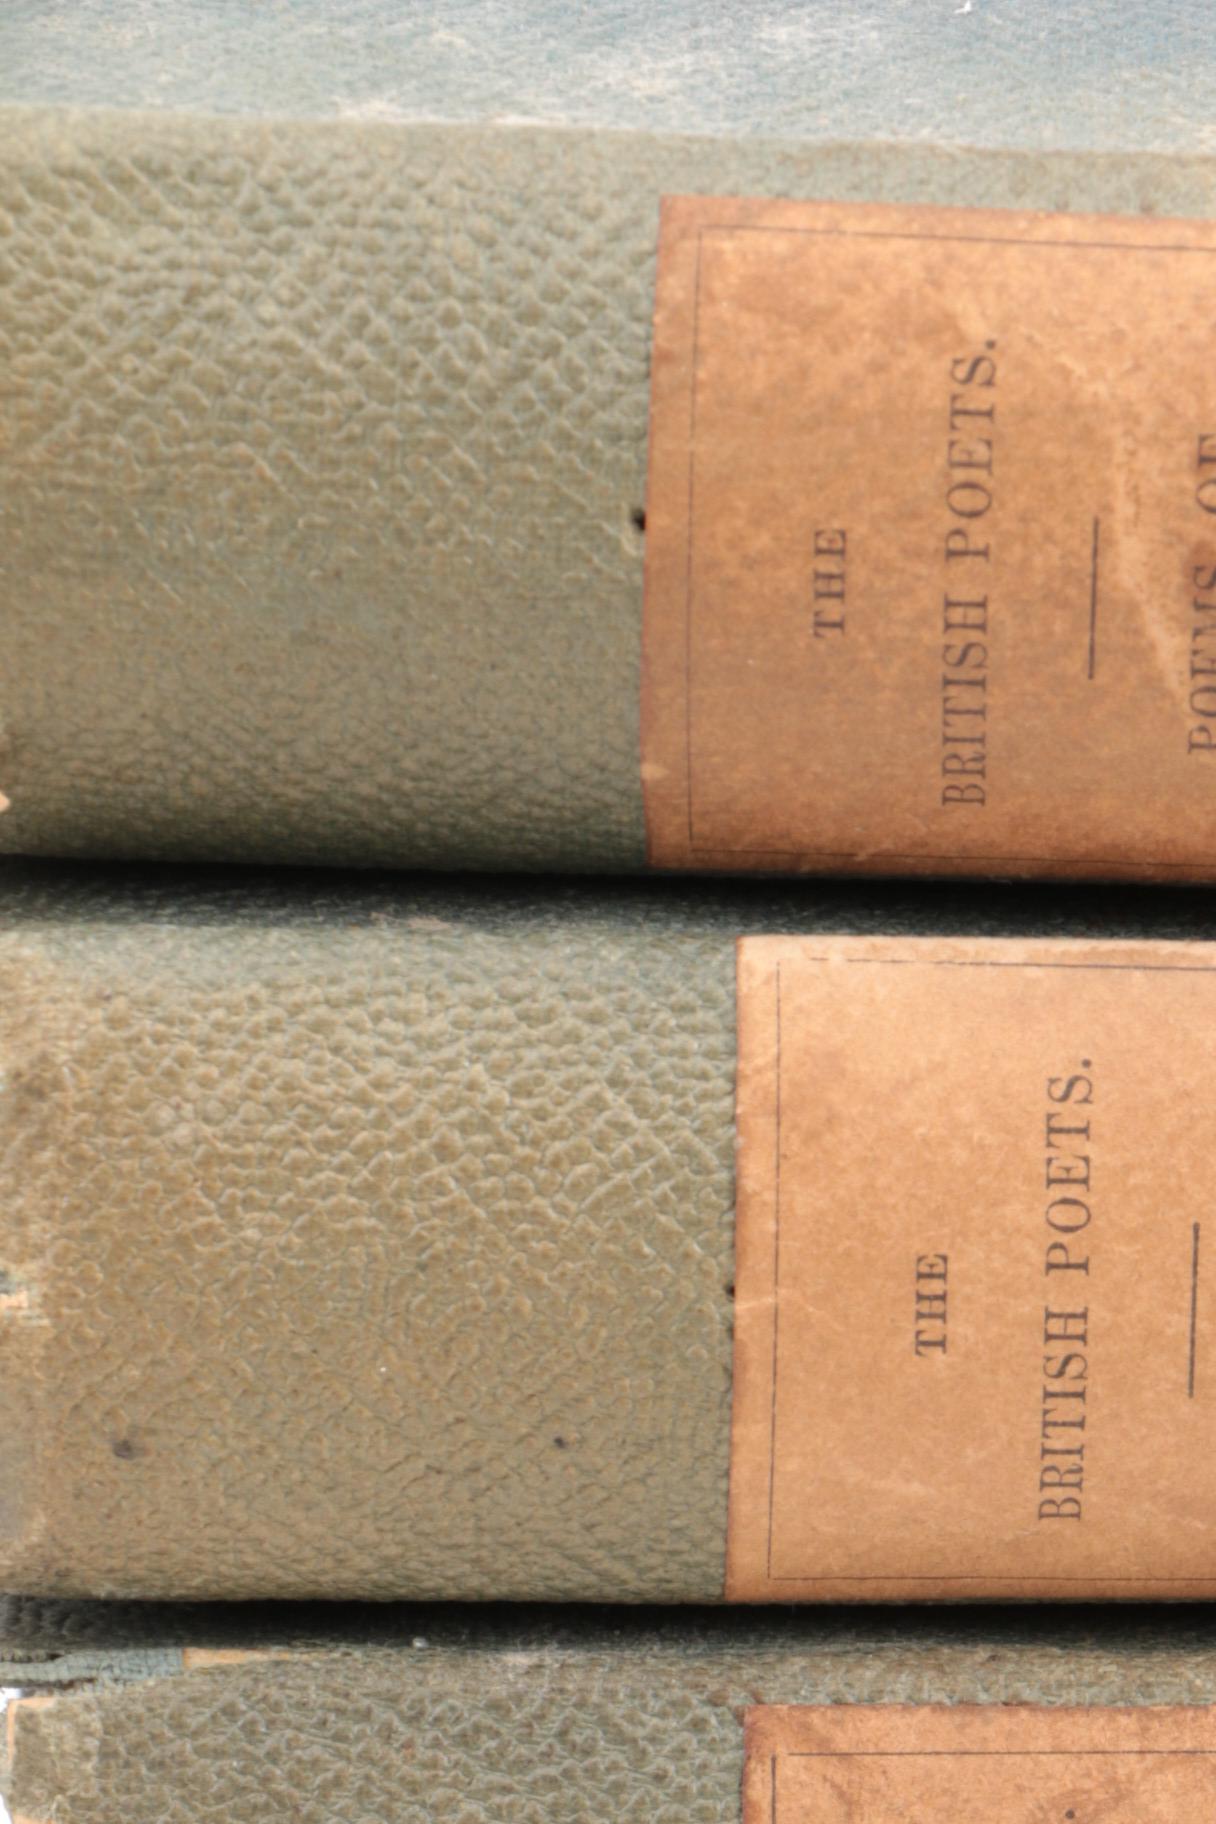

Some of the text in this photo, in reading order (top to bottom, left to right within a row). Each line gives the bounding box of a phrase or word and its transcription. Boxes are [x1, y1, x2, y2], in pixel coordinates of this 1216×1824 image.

[811, 527, 848, 639] THE
[939, 337, 999, 808] BRITISH POETS.
[914, 1252, 949, 1357] THE
[1037, 1055, 1093, 1522] BRITISH POETS.
